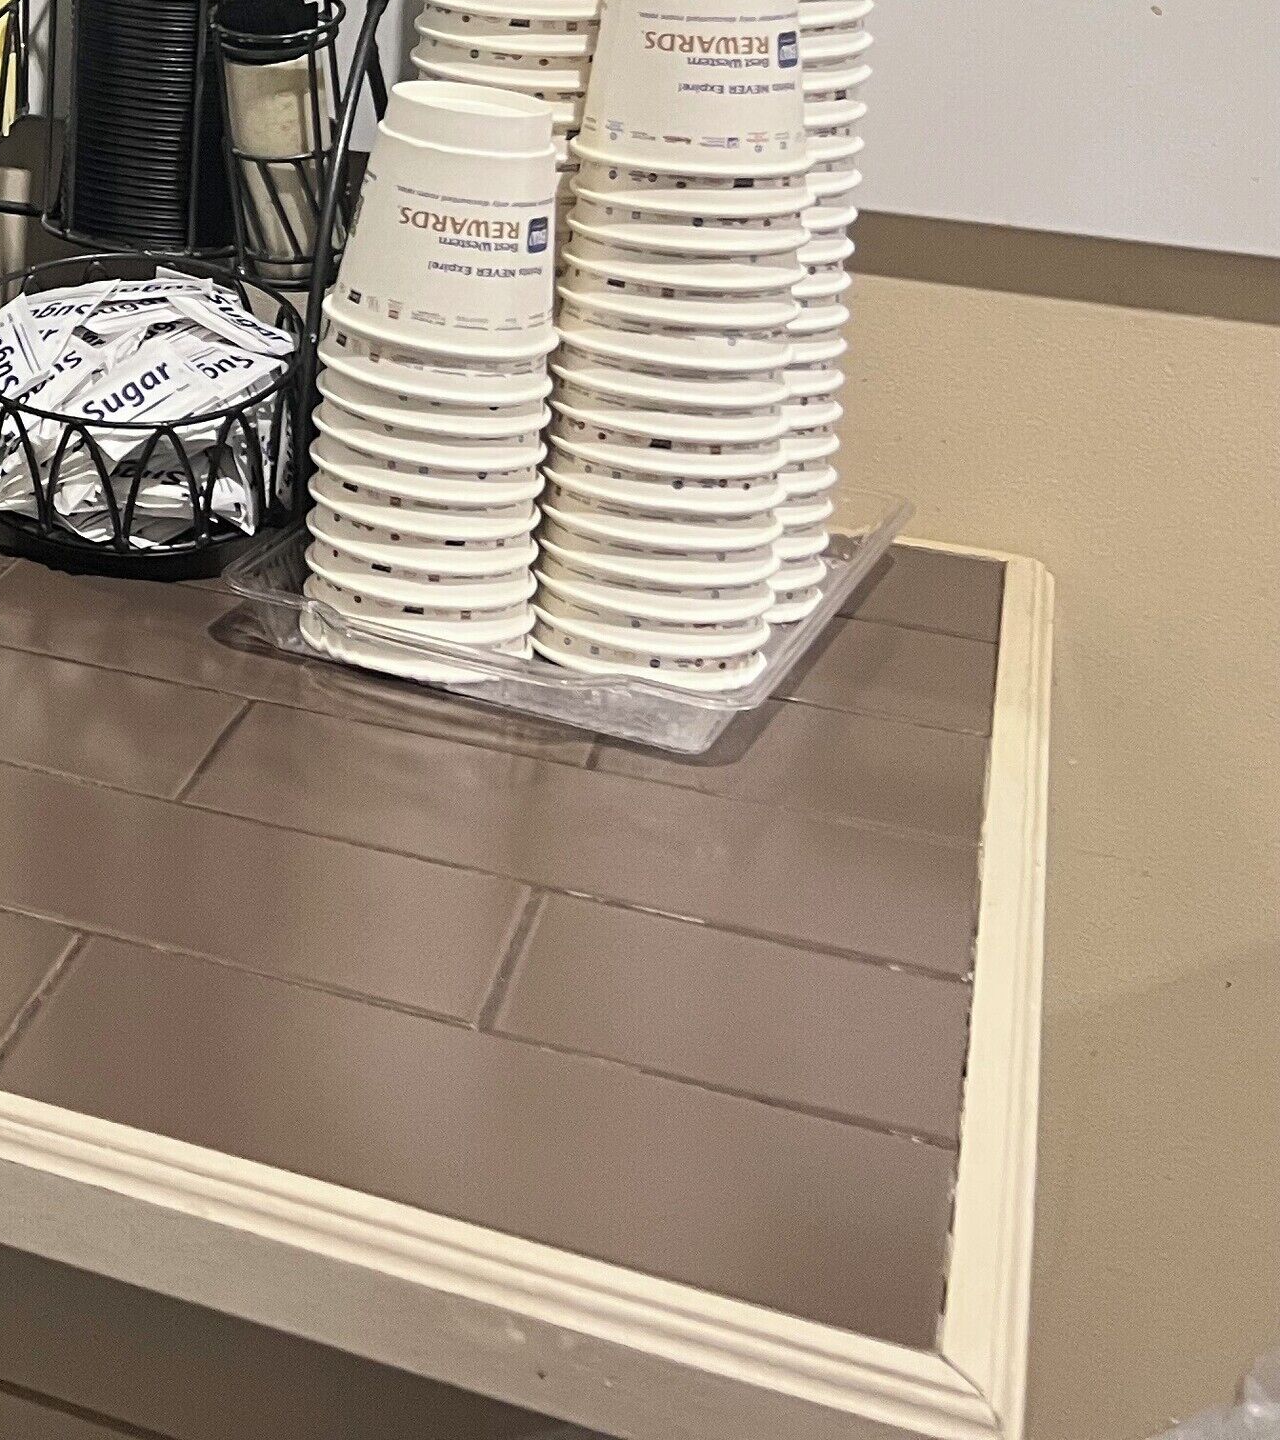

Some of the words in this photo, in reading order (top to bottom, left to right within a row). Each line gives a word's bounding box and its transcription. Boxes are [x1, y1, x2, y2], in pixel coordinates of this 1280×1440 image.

[643, 31, 770, 54] REWARDS
[397, 206, 521, 240] REWARDS
[438, 236, 492, 252] Western
[196, 354, 255, 379] Sug
[82, 360, 171, 422] Sugar
